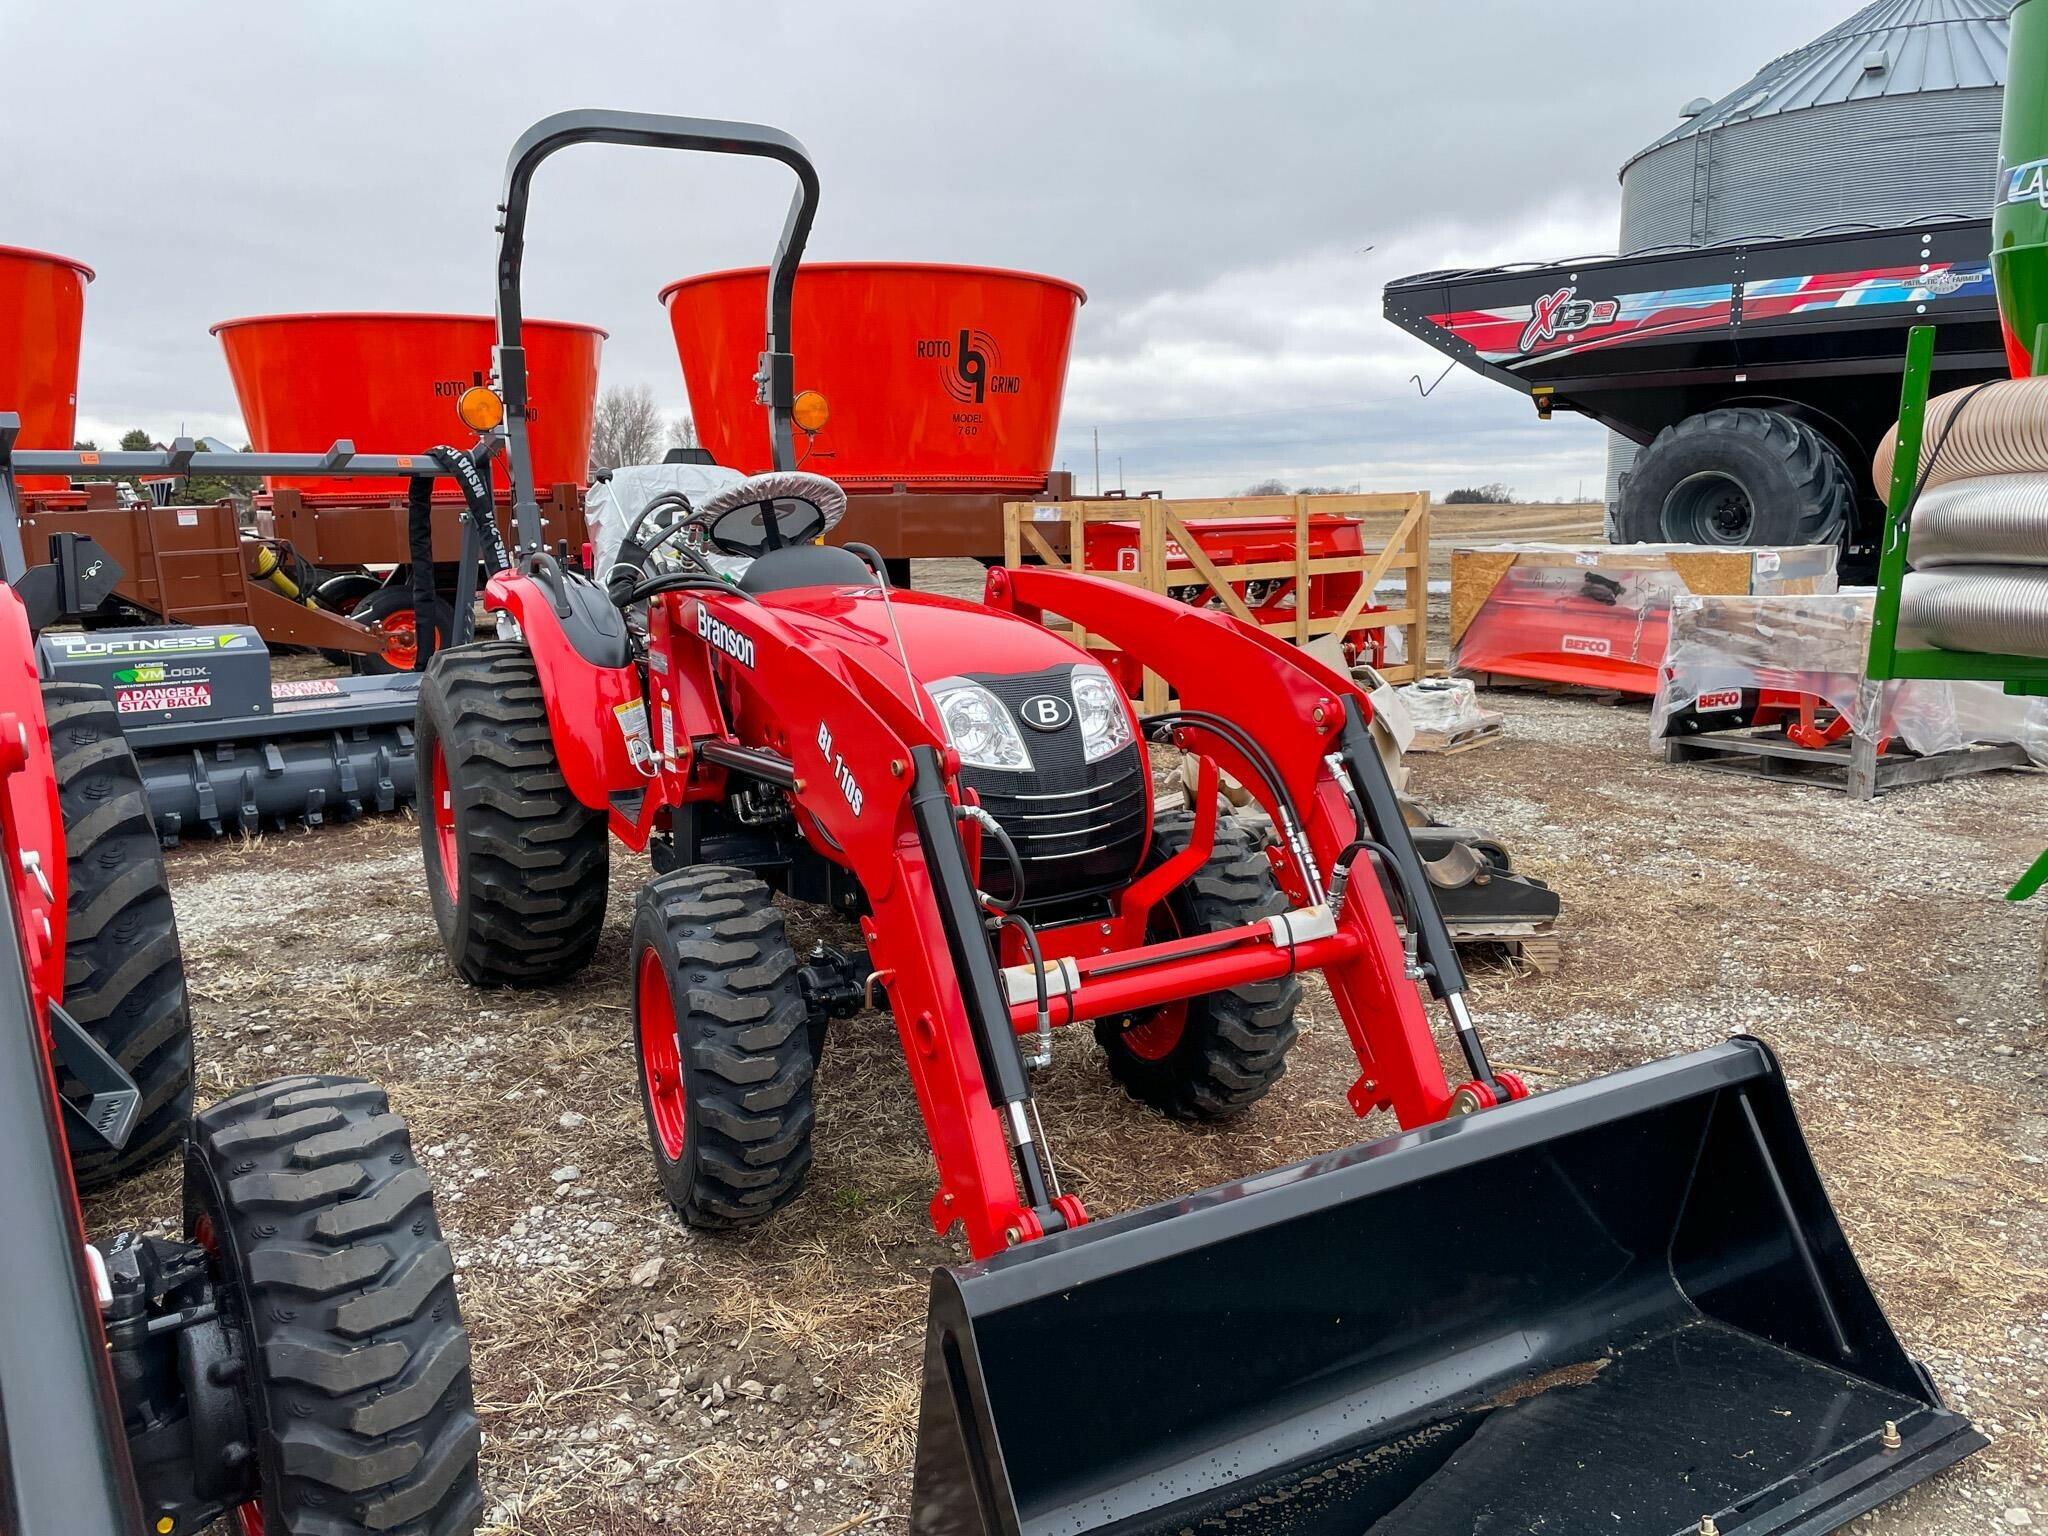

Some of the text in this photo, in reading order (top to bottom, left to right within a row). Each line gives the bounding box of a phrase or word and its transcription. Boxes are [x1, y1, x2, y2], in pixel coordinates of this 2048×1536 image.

[1903, 278, 1938, 287] PATRITIC
[918, 340, 1020, 393] ROTO GRIND
[434, 382, 466, 397] ROTO
[952, 413, 984, 423] MODEL
[958, 426, 978, 436] 760
[457, 457, 487, 498] MSHA
[696, 601, 756, 669] Branson
[66, 635, 215, 655] LOFTNESS
[1565, 638, 1607, 653] BEFCO
[131, 686, 195, 702] DANGER
[272, 688, 300, 698] TAY
[1698, 691, 1739, 708] BEFCO
[121, 696, 209, 712] STAY BACK
[1037, 699, 1060, 723] B
[817, 720, 864, 817] BL 110S
